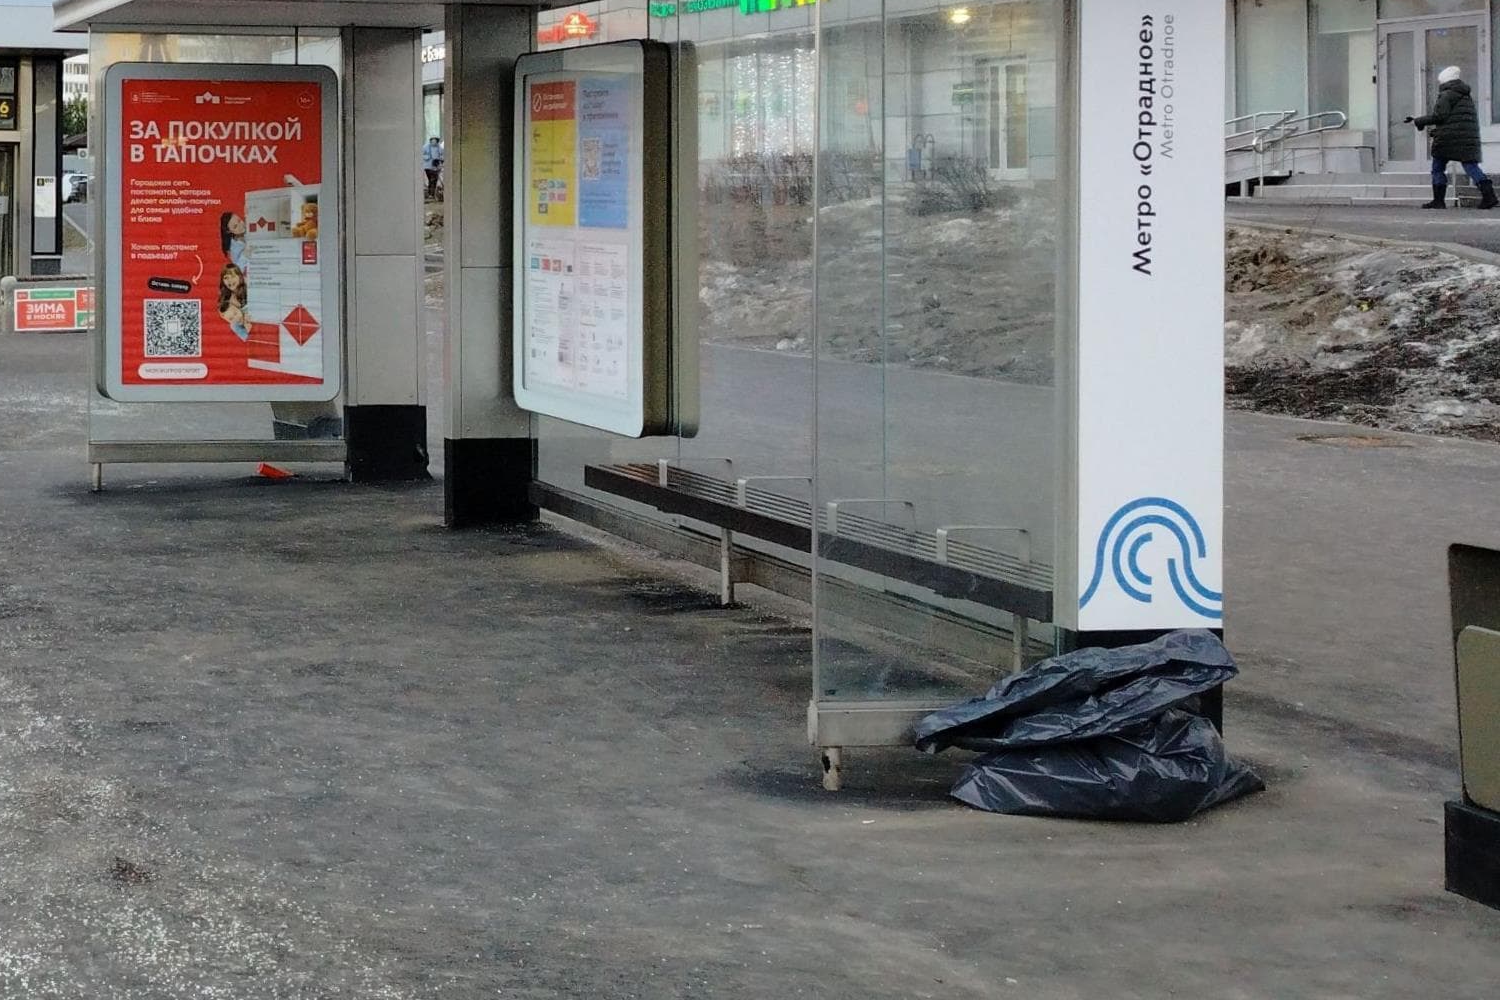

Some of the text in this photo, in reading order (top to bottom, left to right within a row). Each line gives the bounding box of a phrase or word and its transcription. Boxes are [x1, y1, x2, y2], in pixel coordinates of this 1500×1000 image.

[1160, 14, 1175, 159] Metro Otradnoe
[0, 101, 10, 114] 6
[130, 116, 302, 141] ЗА ПОКУПКОЙ
[130, 144, 278, 164] В ТАПОЧКАХ
[1132, 13, 1157, 276] Метро «Отрадное»
[26, 303, 66, 314] ЗИМА
